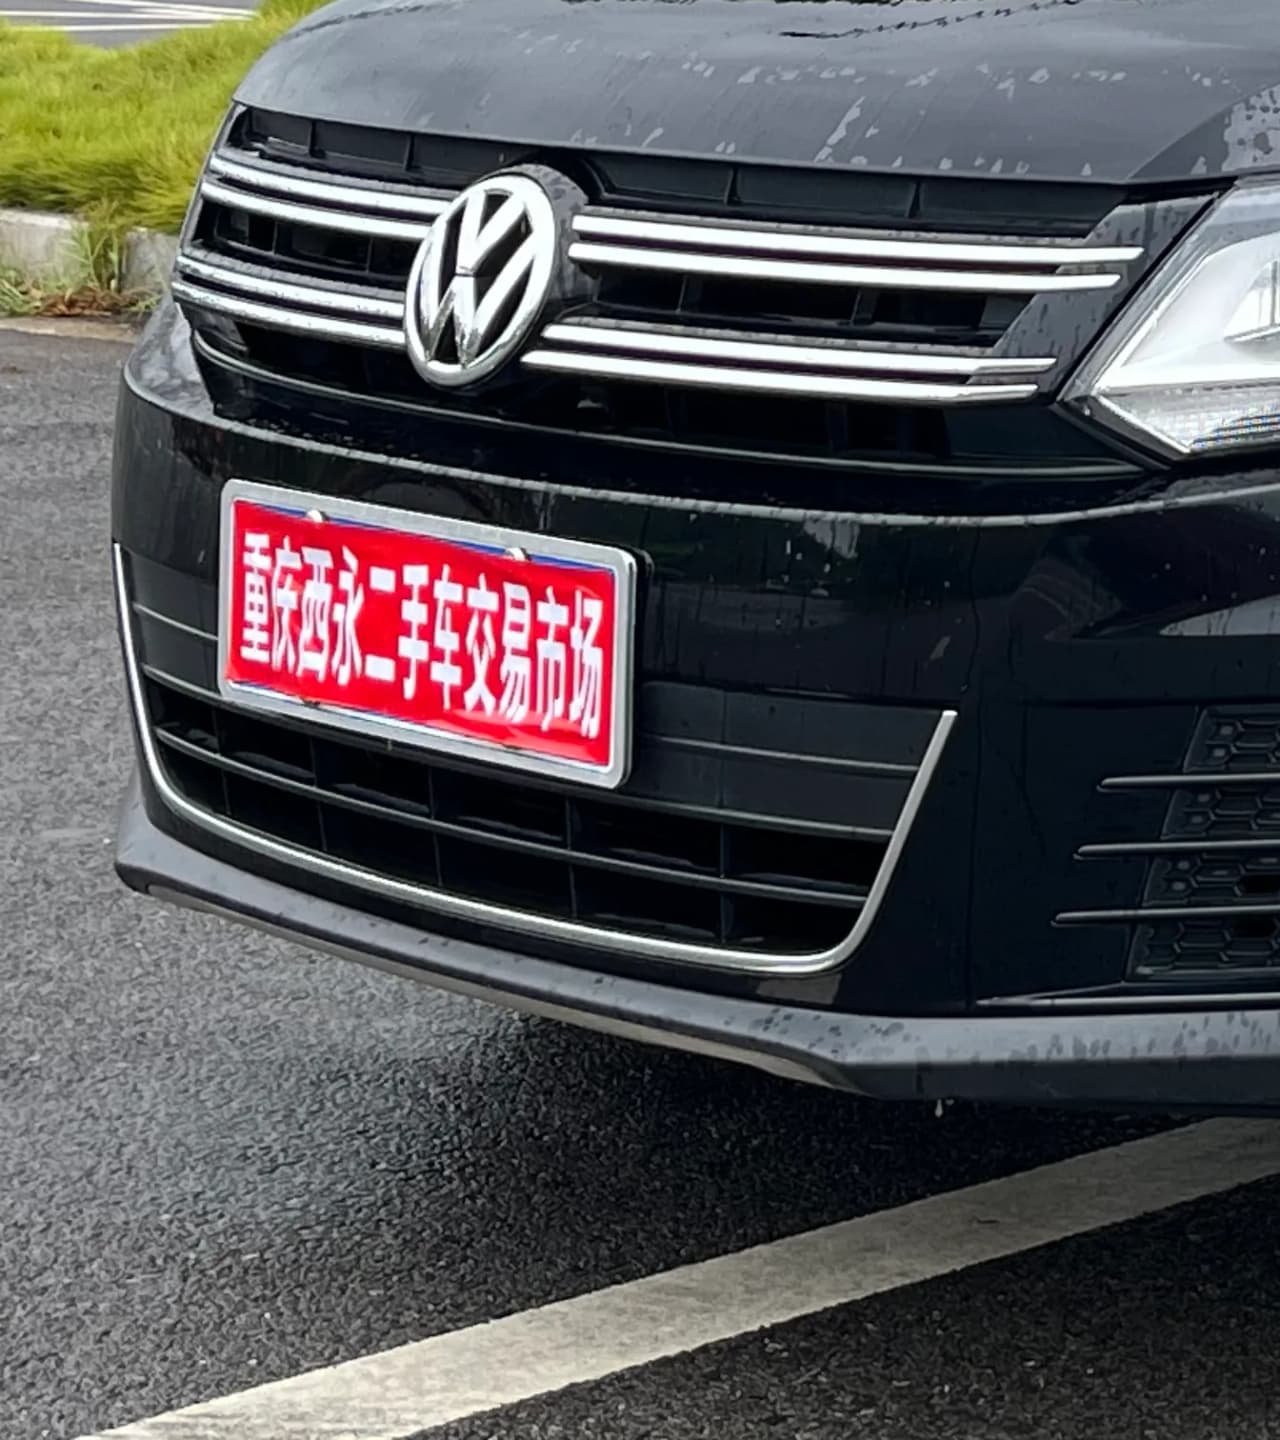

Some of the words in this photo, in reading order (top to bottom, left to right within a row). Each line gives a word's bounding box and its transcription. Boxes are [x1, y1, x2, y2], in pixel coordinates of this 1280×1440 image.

[240, 532, 605, 740] 重庆西永二手车交易市场
